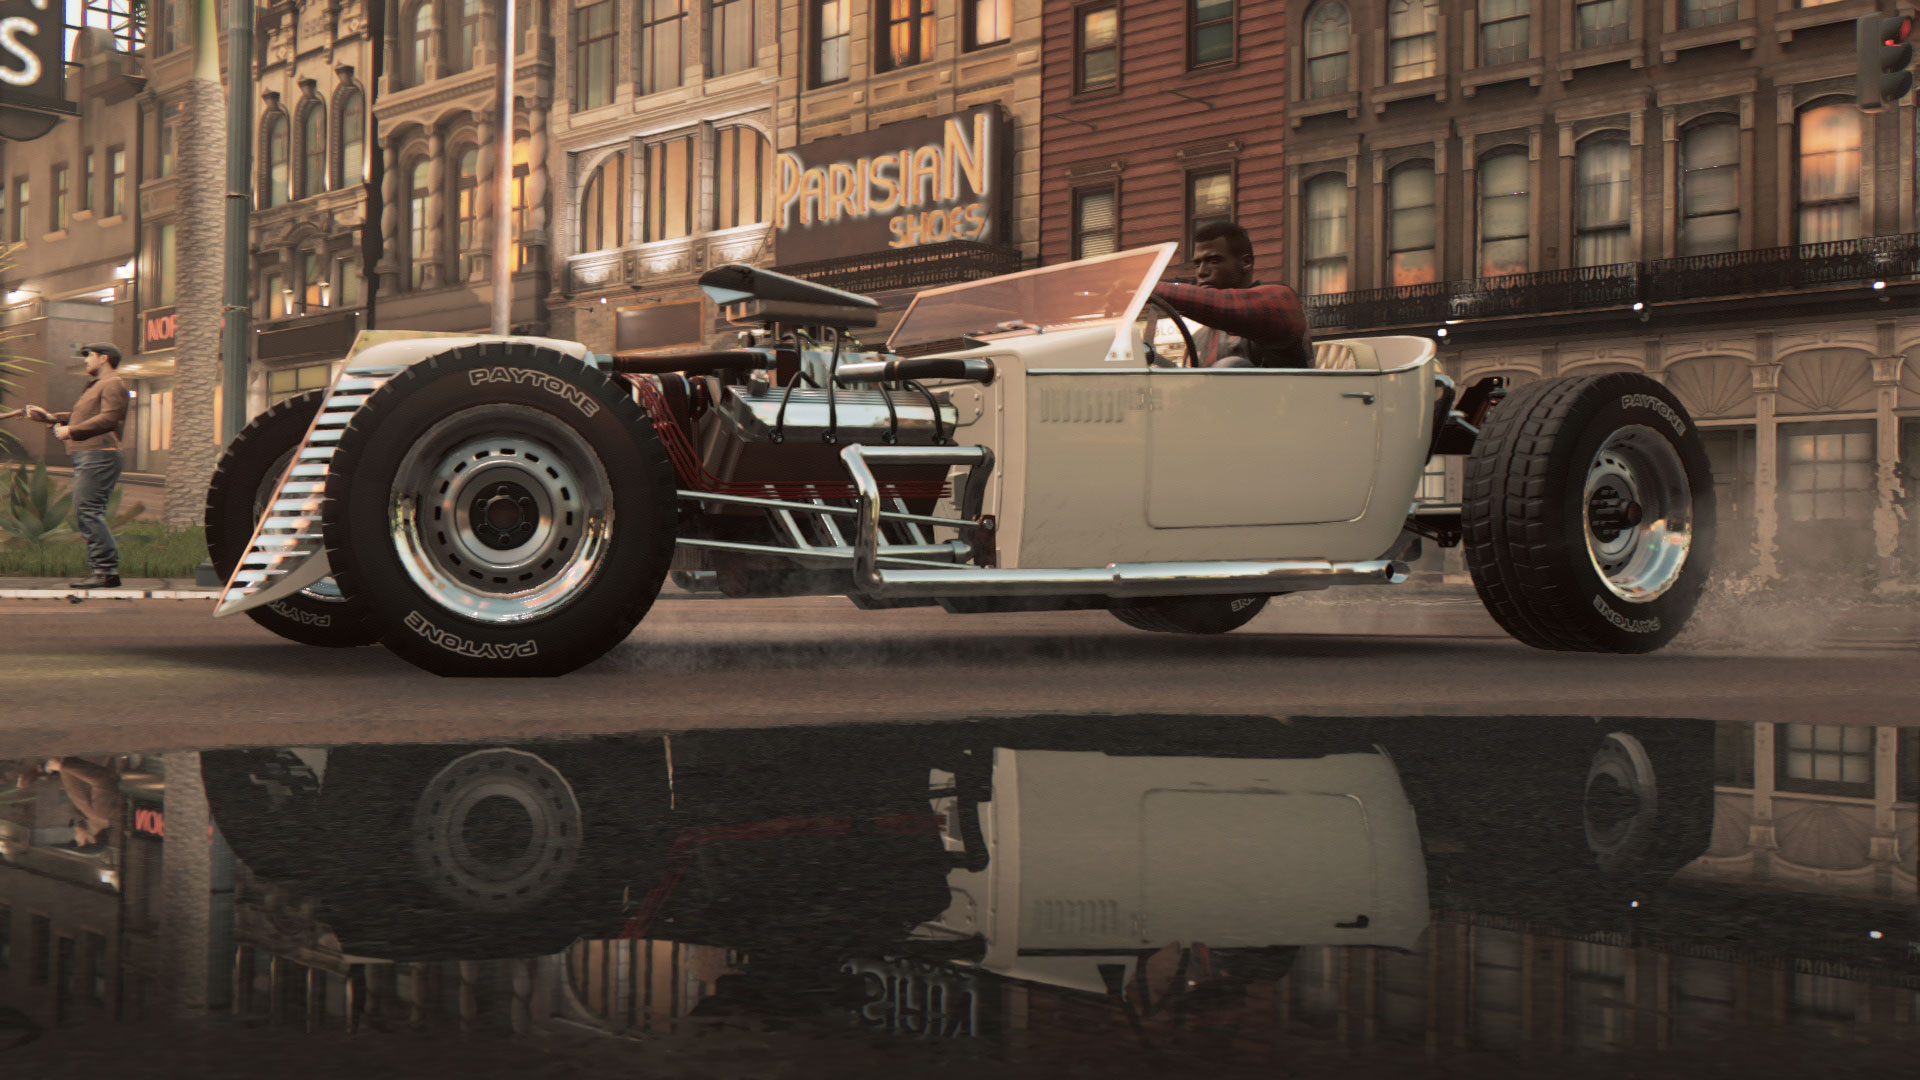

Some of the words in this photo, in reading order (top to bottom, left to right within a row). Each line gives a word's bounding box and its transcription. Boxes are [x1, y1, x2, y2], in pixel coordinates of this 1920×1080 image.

[776, 113, 986, 230] PARISIAN
[889, 203, 985, 248] SHOES
[468, 367, 600, 418] PAYTONE
[1621, 393, 1686, 437] PAYTONE
[267, 599, 331, 627] PAYT
[404, 610, 538, 659] PAYTONE
[1593, 594, 1661, 633] PAYTONE
